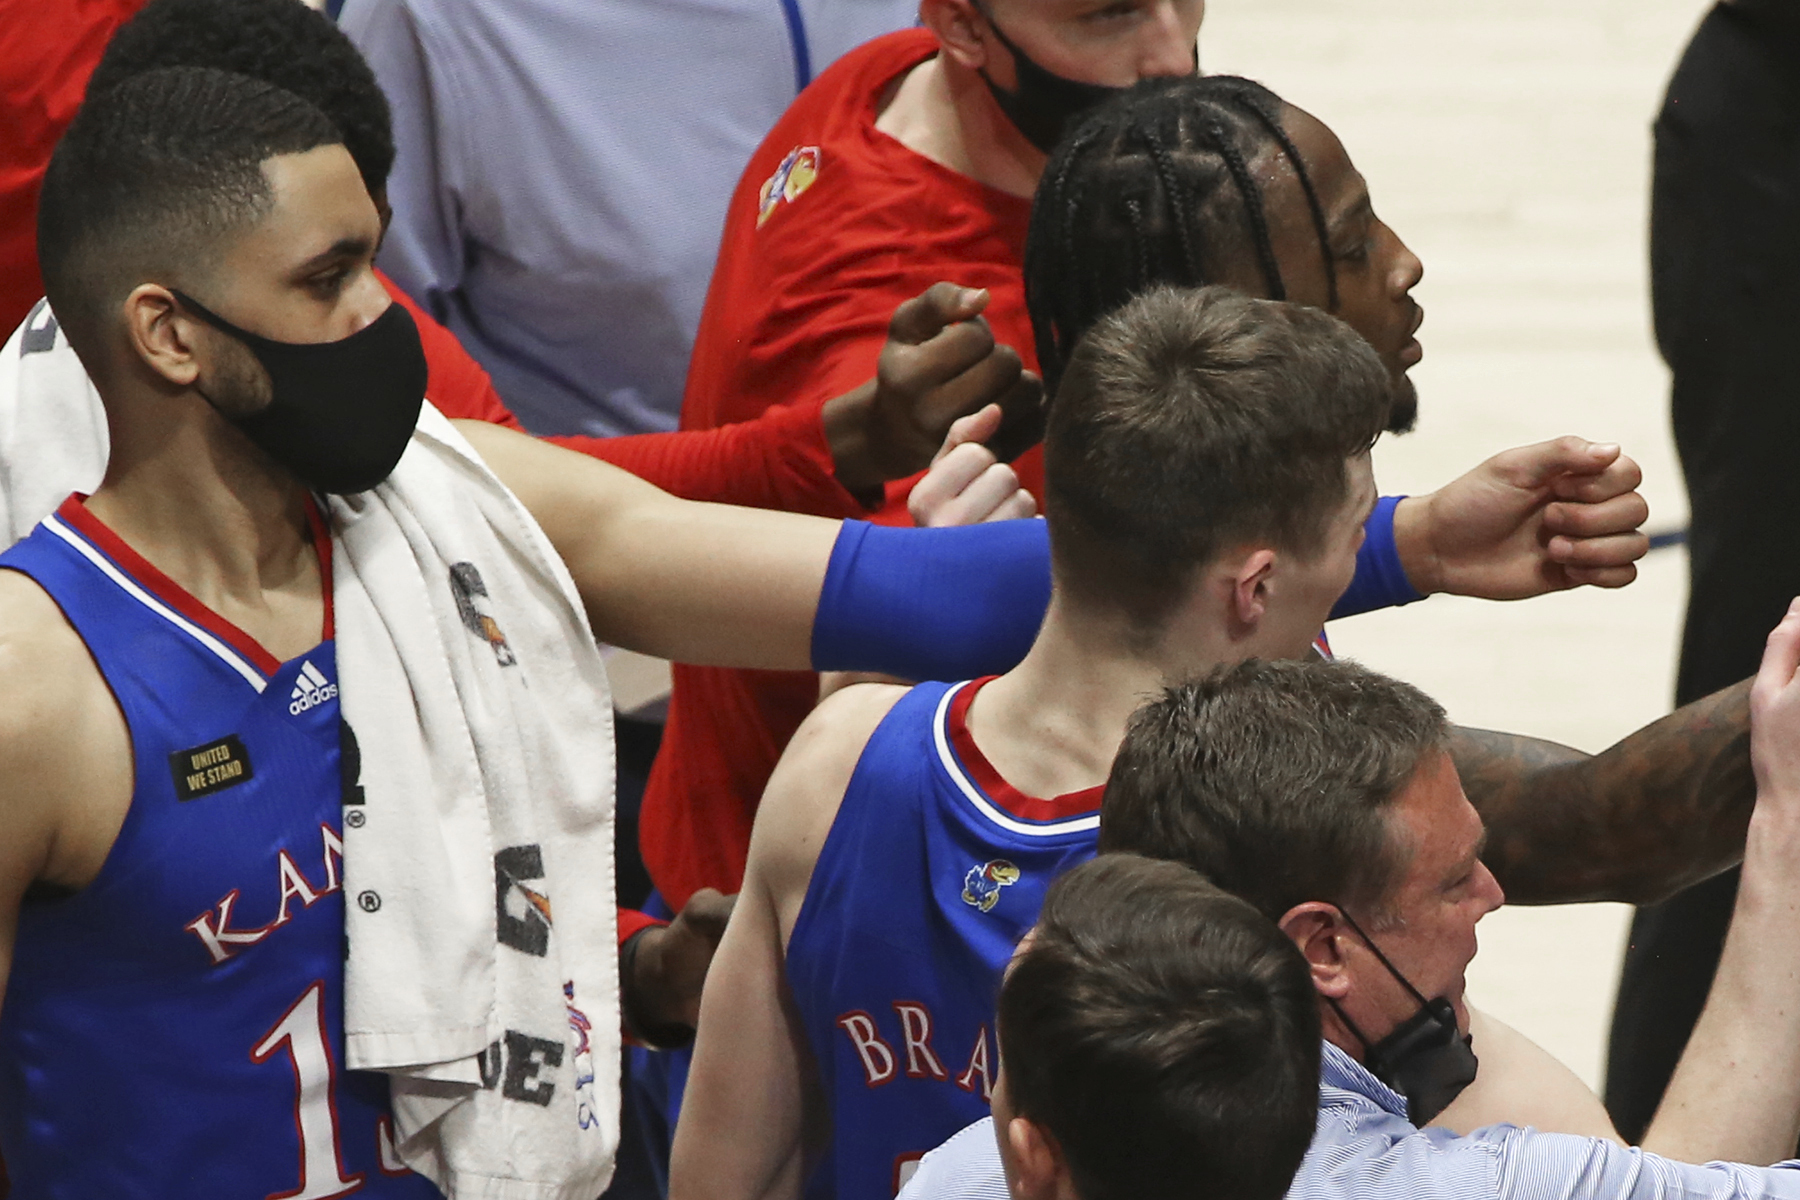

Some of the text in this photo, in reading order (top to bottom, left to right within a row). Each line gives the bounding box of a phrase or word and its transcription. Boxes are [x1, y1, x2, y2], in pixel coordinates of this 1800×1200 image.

[288, 683, 338, 716] adidas
[190, 743, 231, 771] UNITED
[186, 759, 243, 791] WE STAND
